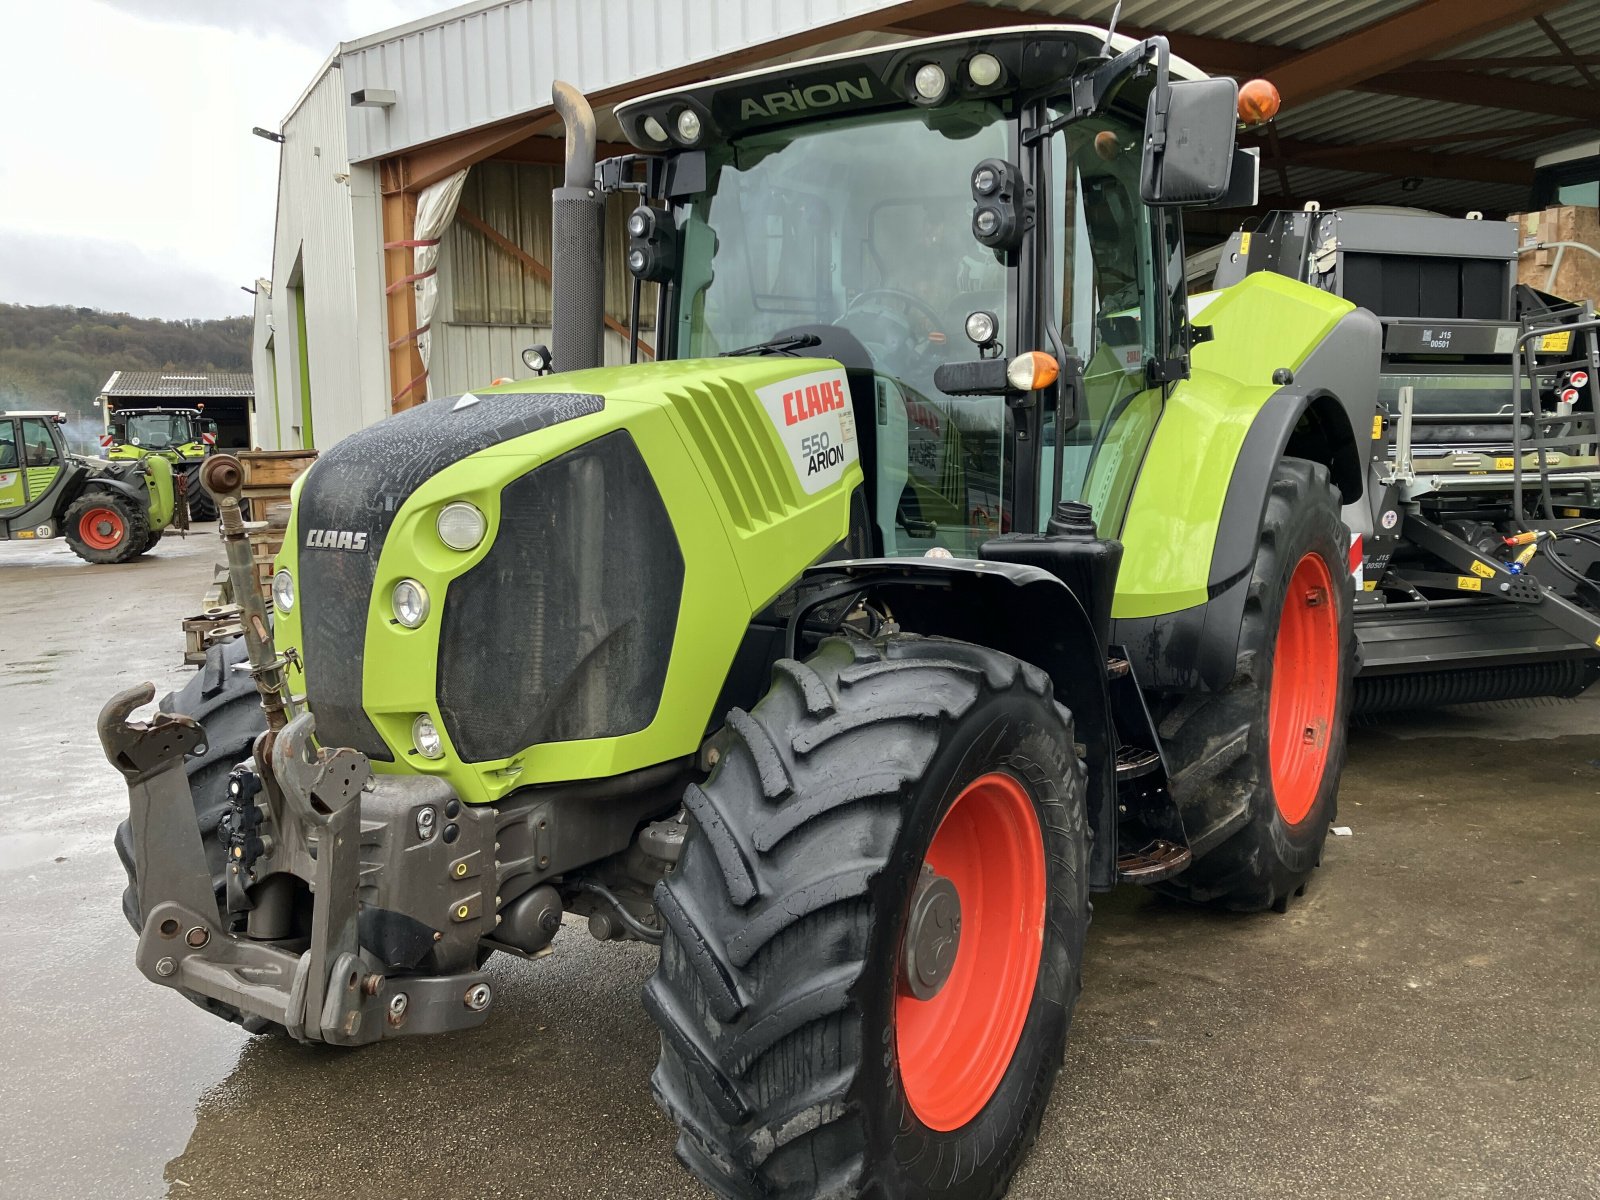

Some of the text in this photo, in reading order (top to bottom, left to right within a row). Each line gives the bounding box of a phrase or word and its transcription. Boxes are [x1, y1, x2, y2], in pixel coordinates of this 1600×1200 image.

[740, 77, 874, 121] ARION
[1430, 340, 1449, 348] 00501
[1439, 331, 1451, 339] J15
[782, 379, 845, 427] CLAAS
[801, 431, 830, 459] 550
[807, 443, 845, 477] ARION
[38, 527, 49, 536] 30
[306, 529, 368, 551] CLAAS
